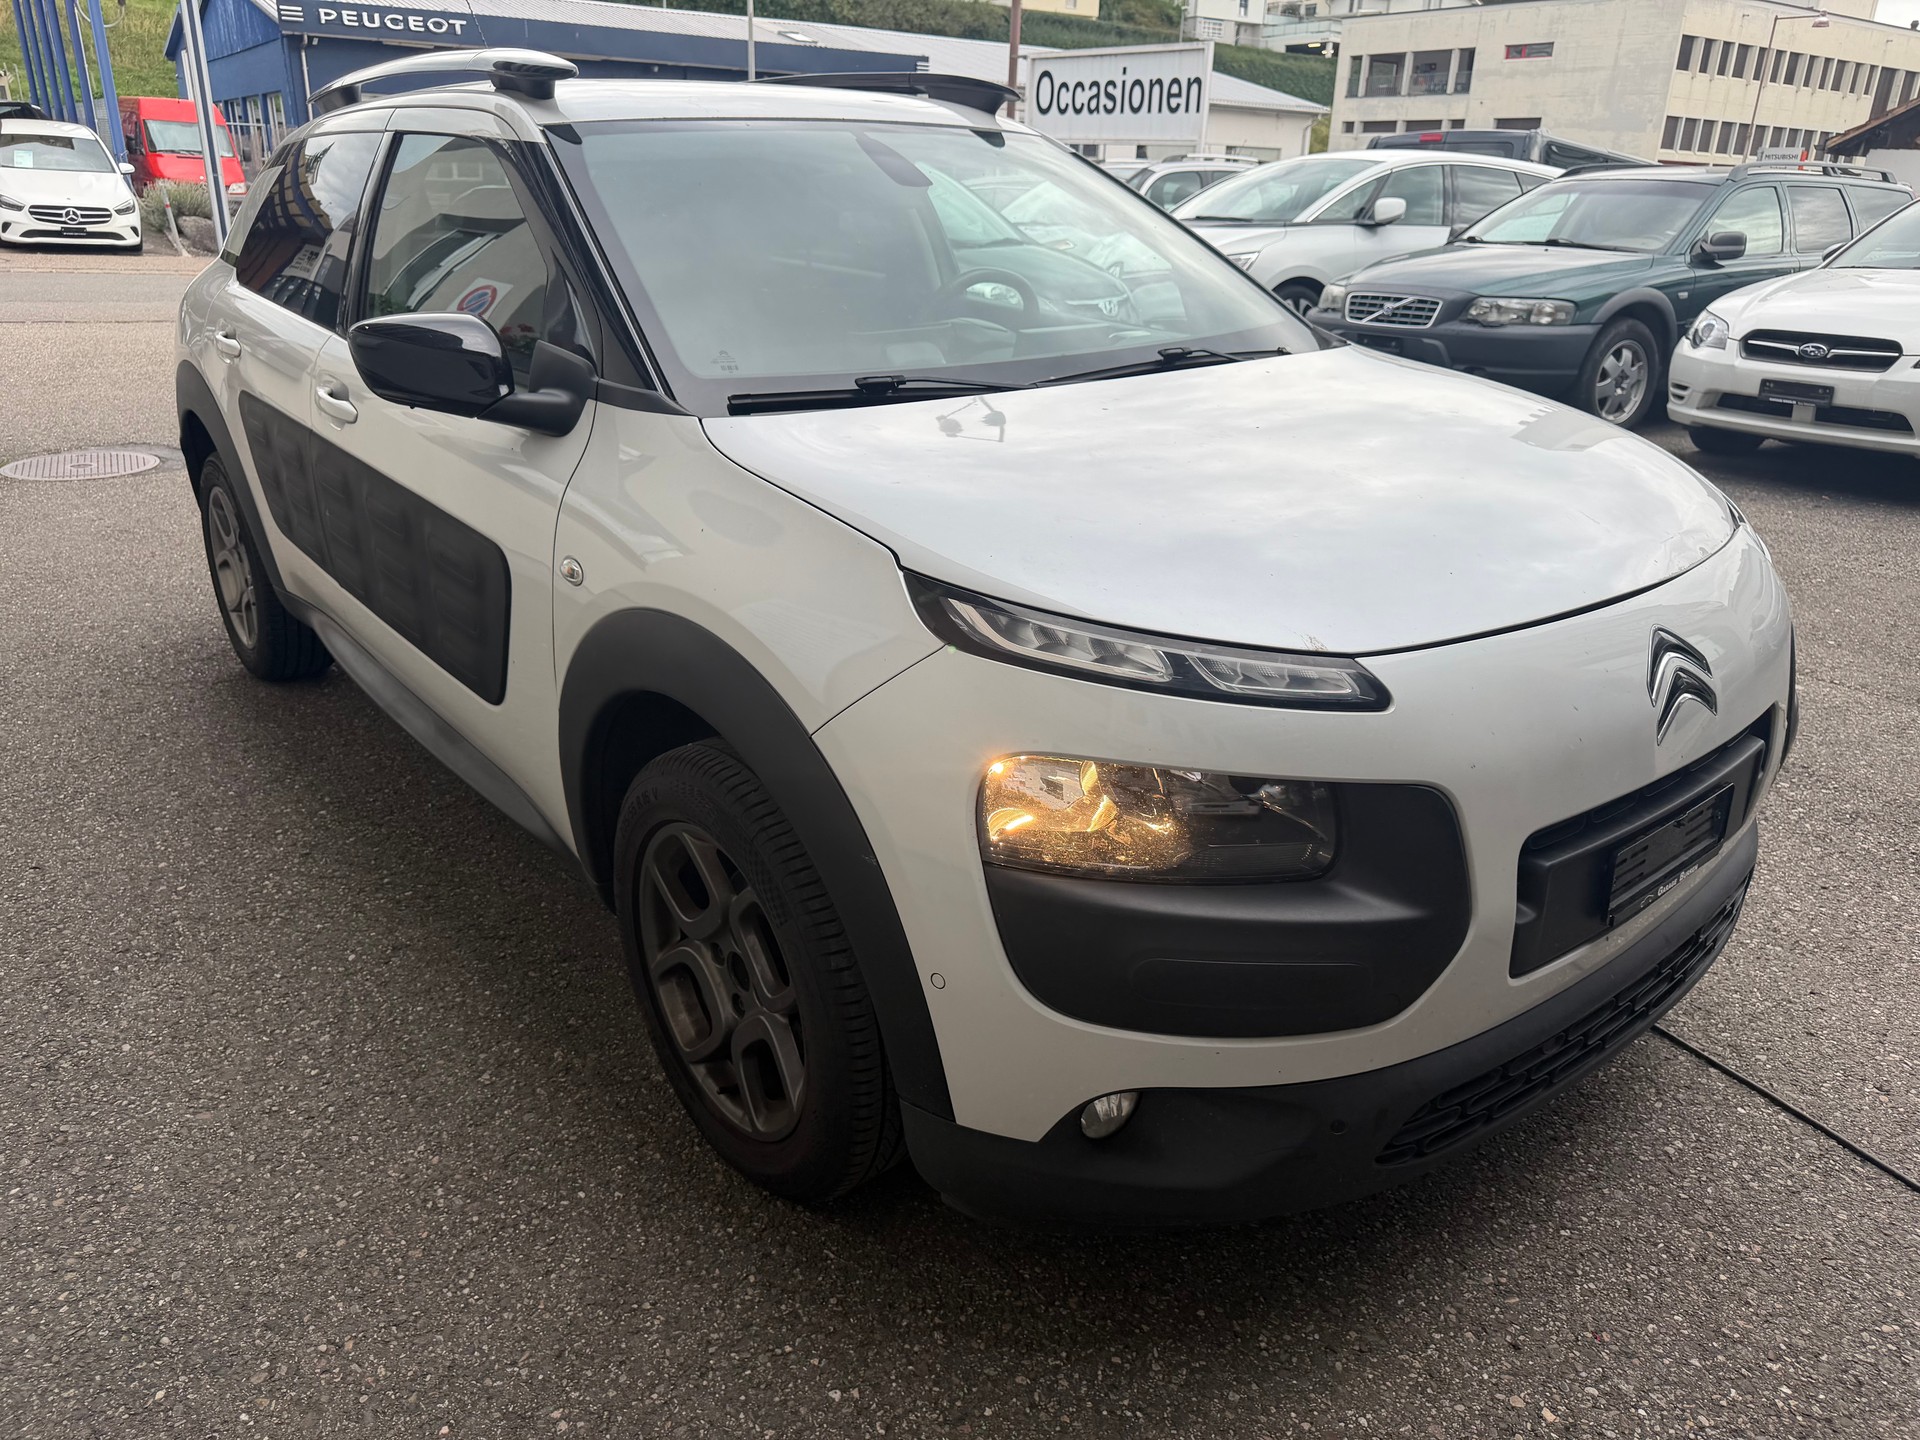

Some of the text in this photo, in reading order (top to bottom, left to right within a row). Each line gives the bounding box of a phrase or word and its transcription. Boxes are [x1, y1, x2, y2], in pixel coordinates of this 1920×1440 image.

[318, 7, 467, 36] PEUGEOT
[1036, 66, 1203, 115] Occasionen
[1764, 152, 1799, 161] MITSUBISHI
